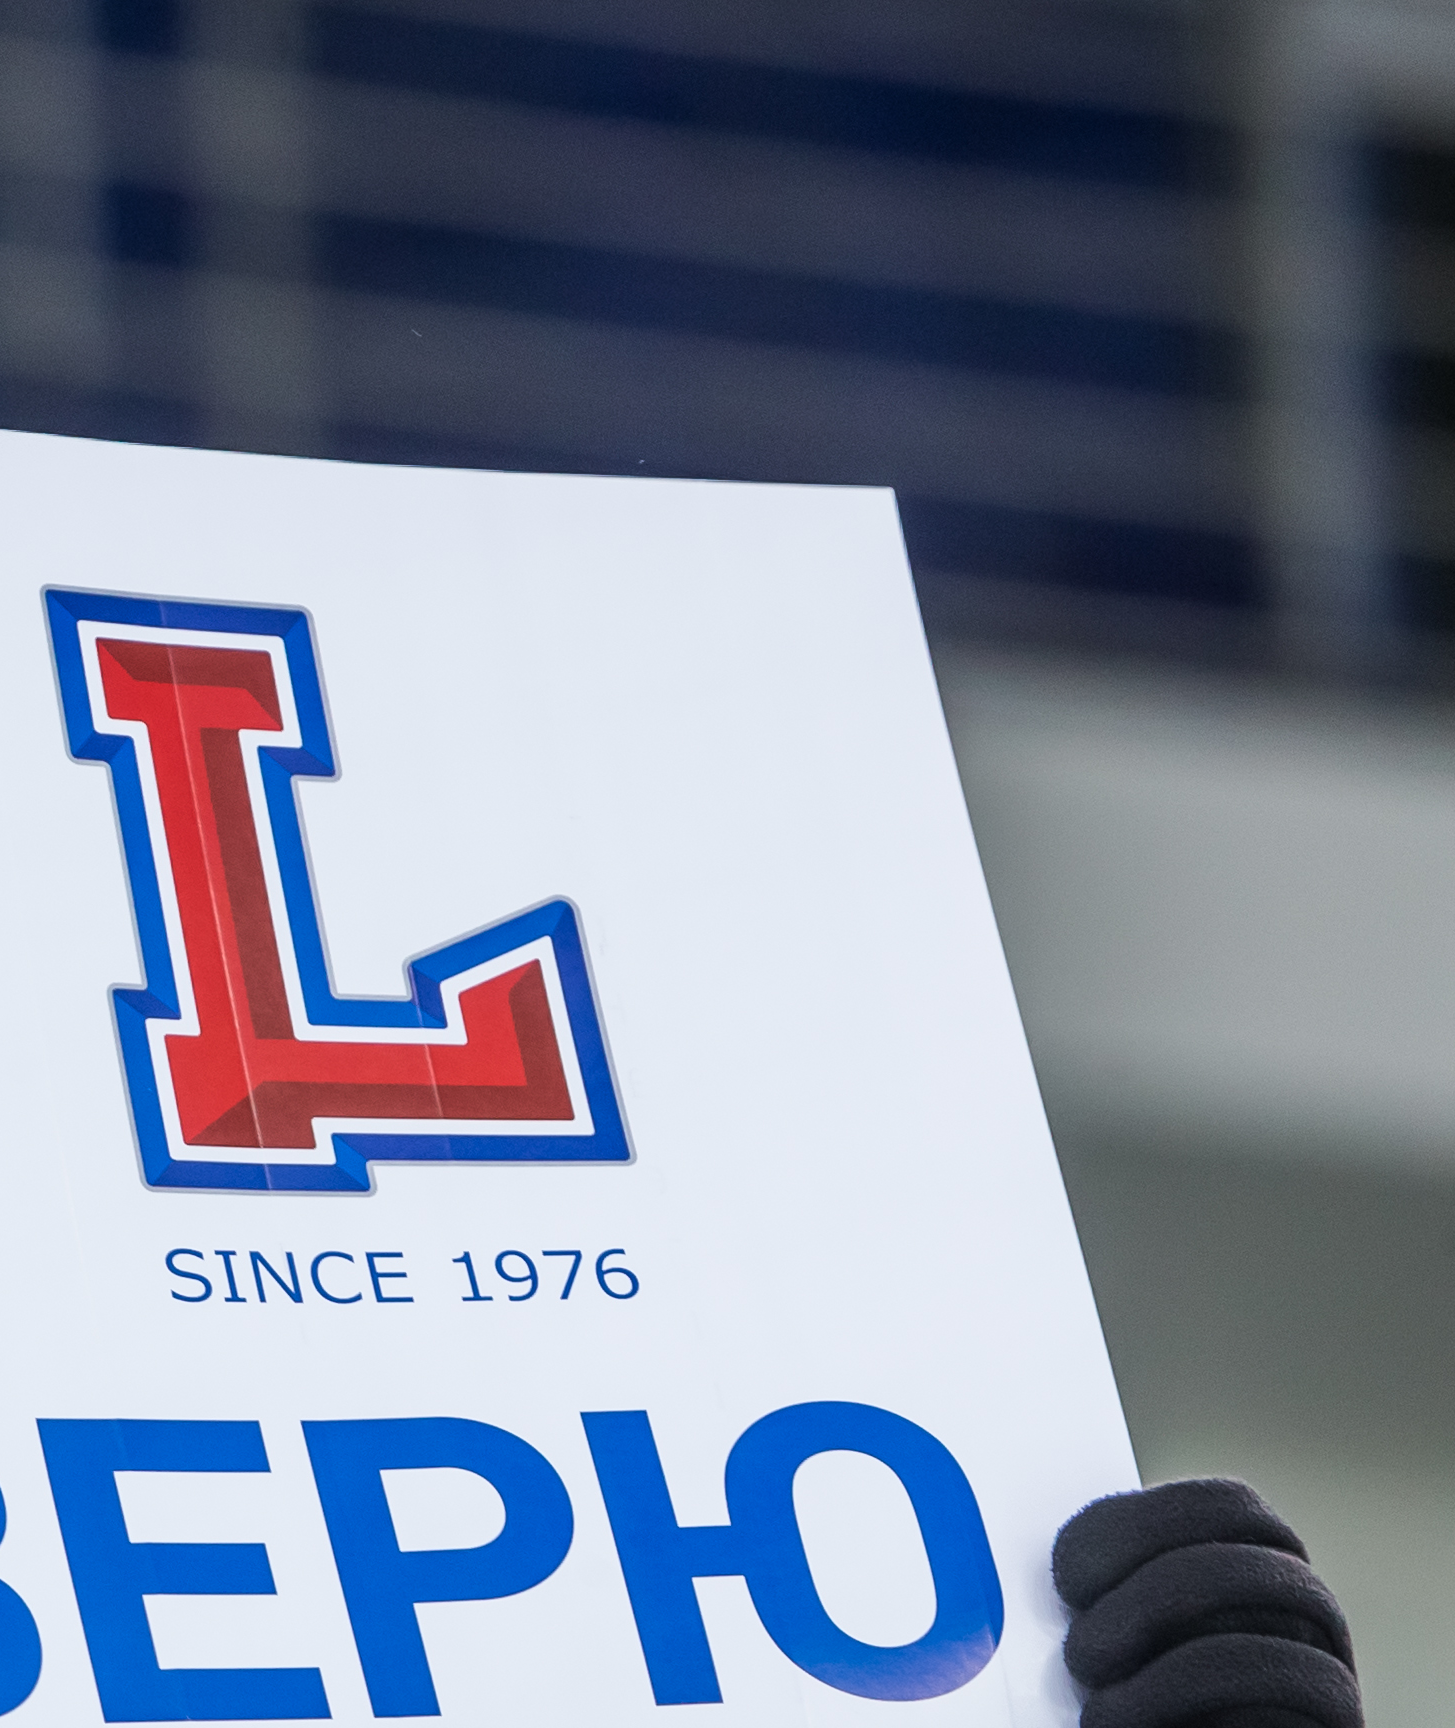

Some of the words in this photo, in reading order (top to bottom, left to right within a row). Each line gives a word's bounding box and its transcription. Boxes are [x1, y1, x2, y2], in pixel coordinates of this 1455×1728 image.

[42, 584, 636, 1196] L
[164, 1248, 415, 1305] SINCE
[452, 1248, 641, 1303] 1976
